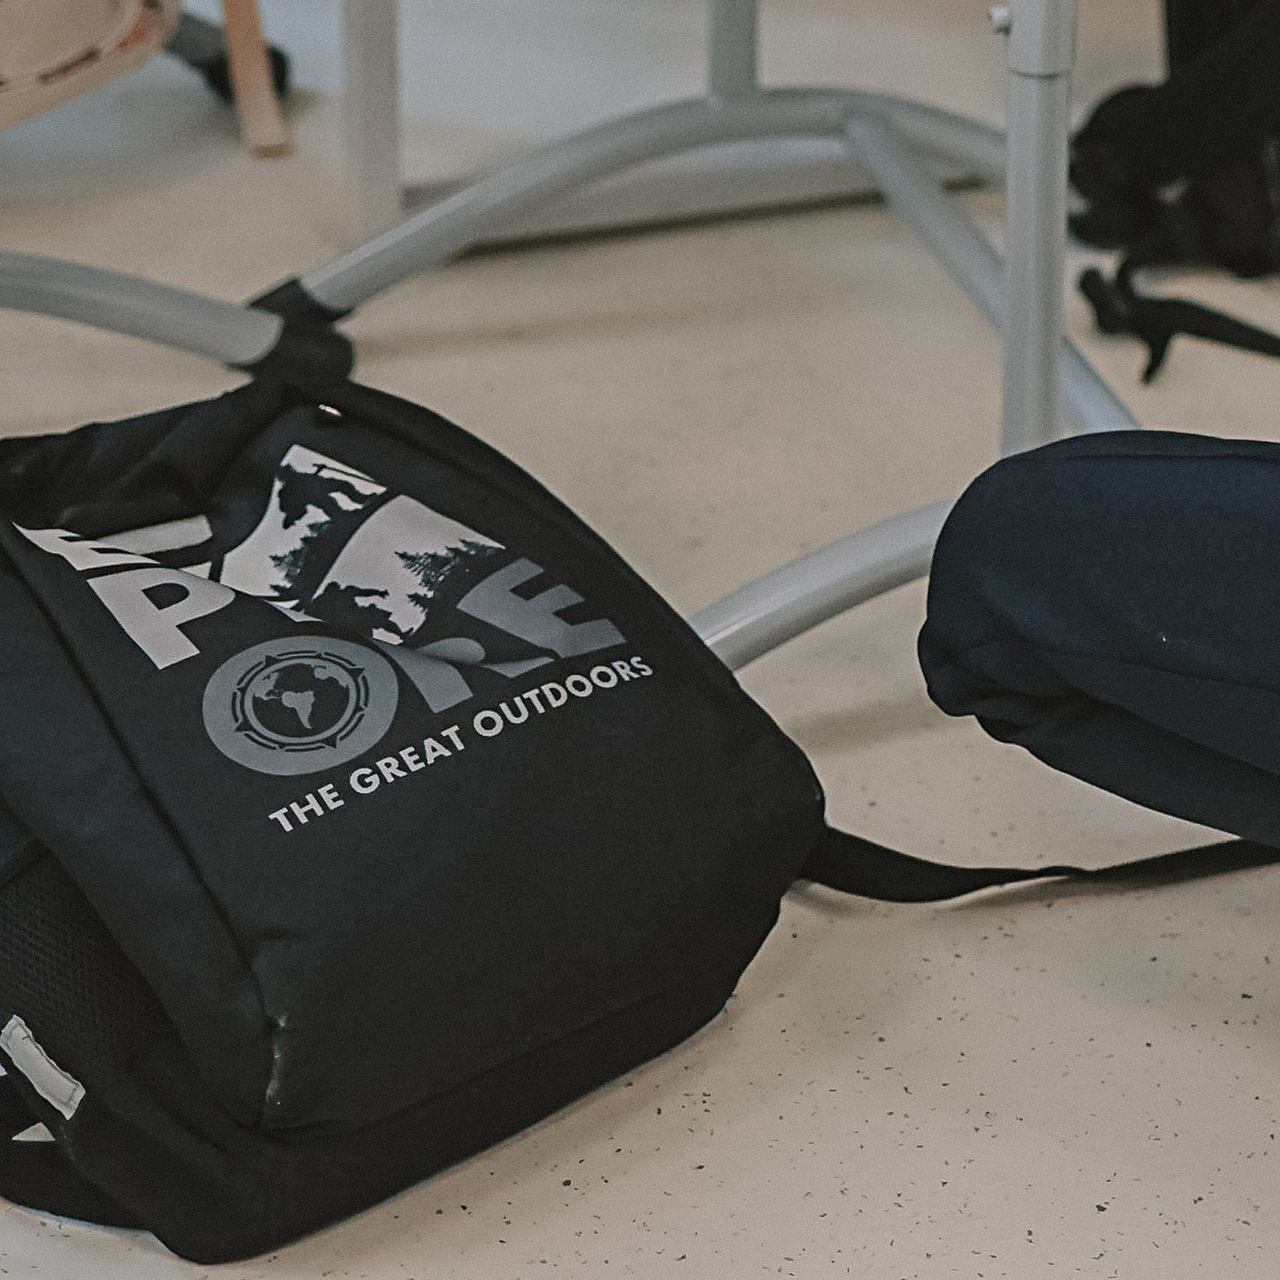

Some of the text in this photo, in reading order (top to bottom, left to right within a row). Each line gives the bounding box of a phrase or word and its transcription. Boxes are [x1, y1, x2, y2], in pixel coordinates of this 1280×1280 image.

[267, 656, 653, 832] THE GREAT OUTDOORS
